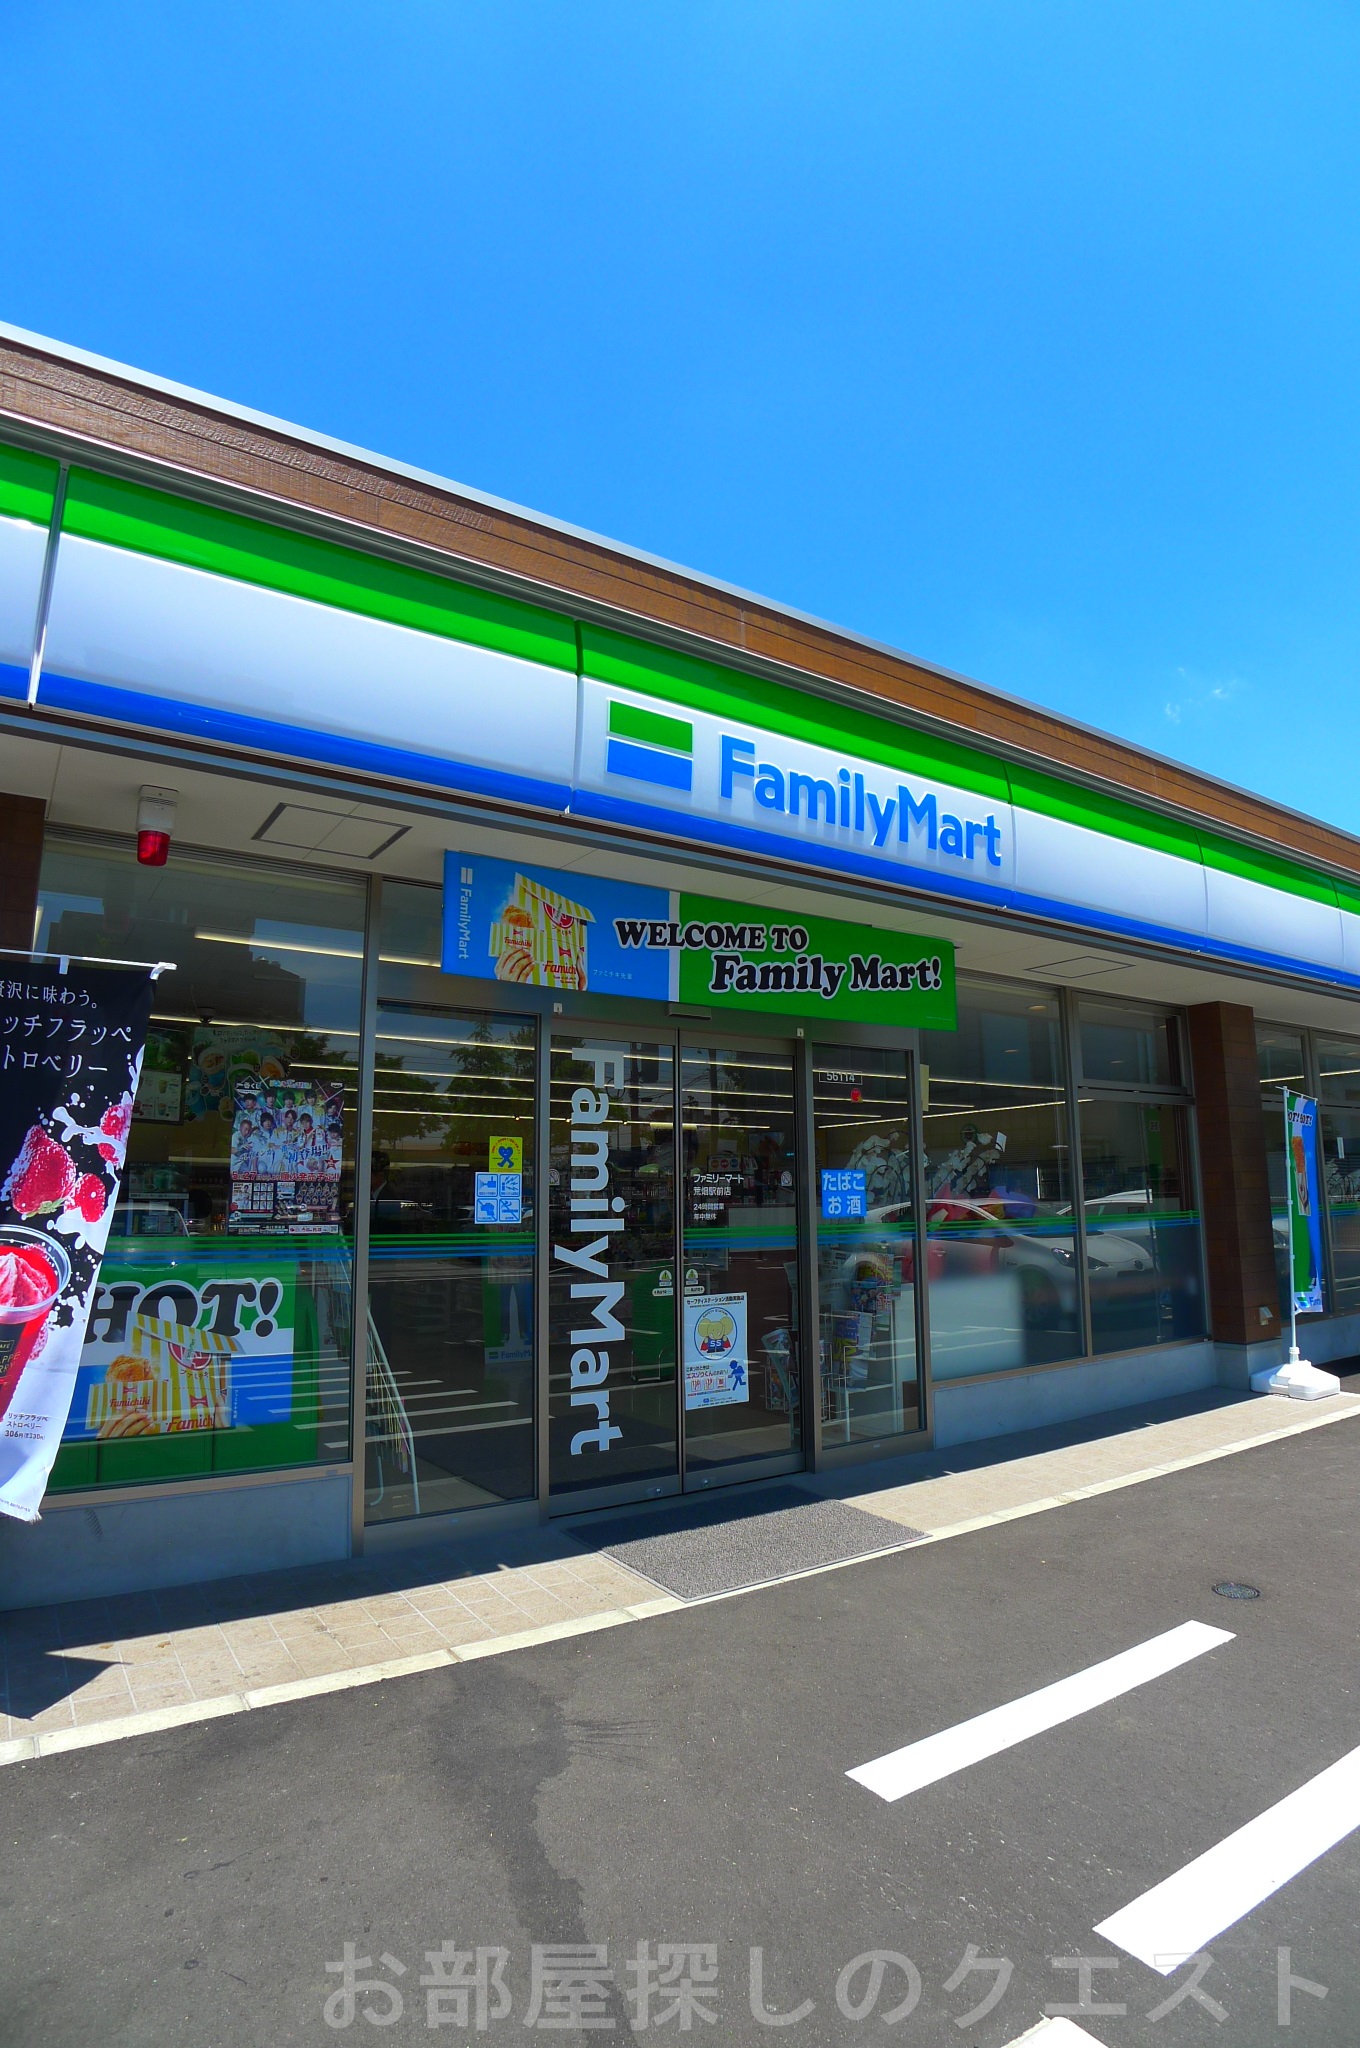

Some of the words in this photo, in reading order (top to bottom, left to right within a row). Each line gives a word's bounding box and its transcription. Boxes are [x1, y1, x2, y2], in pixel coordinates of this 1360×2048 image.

[719, 731, 1002, 868] FamilyMart
[458, 888, 473, 960] FamilyMart
[613, 920, 766, 950] WELCOME
[771, 925, 808, 951] TO
[709, 954, 845, 998] Family
[850, 956, 942, 990] Mart!
[0, 980, 98, 1009] 沢に味わう。
[826, 1071, 856, 1083] 56114
[693, 1173, 745, 1184] ファミリーマート
[822, 1172, 865, 1191] たばこ
[693, 1186, 732, 1196] 荒畑駅前店
[827, 1195, 862, 1215] お酒
[554, 1046, 626, 1456] FamilyMart
[83, 1279, 283, 1345] HOT!
[710, 1339, 722, 1348] SS
[6, 1420, 42, 1429] ストロベリー
